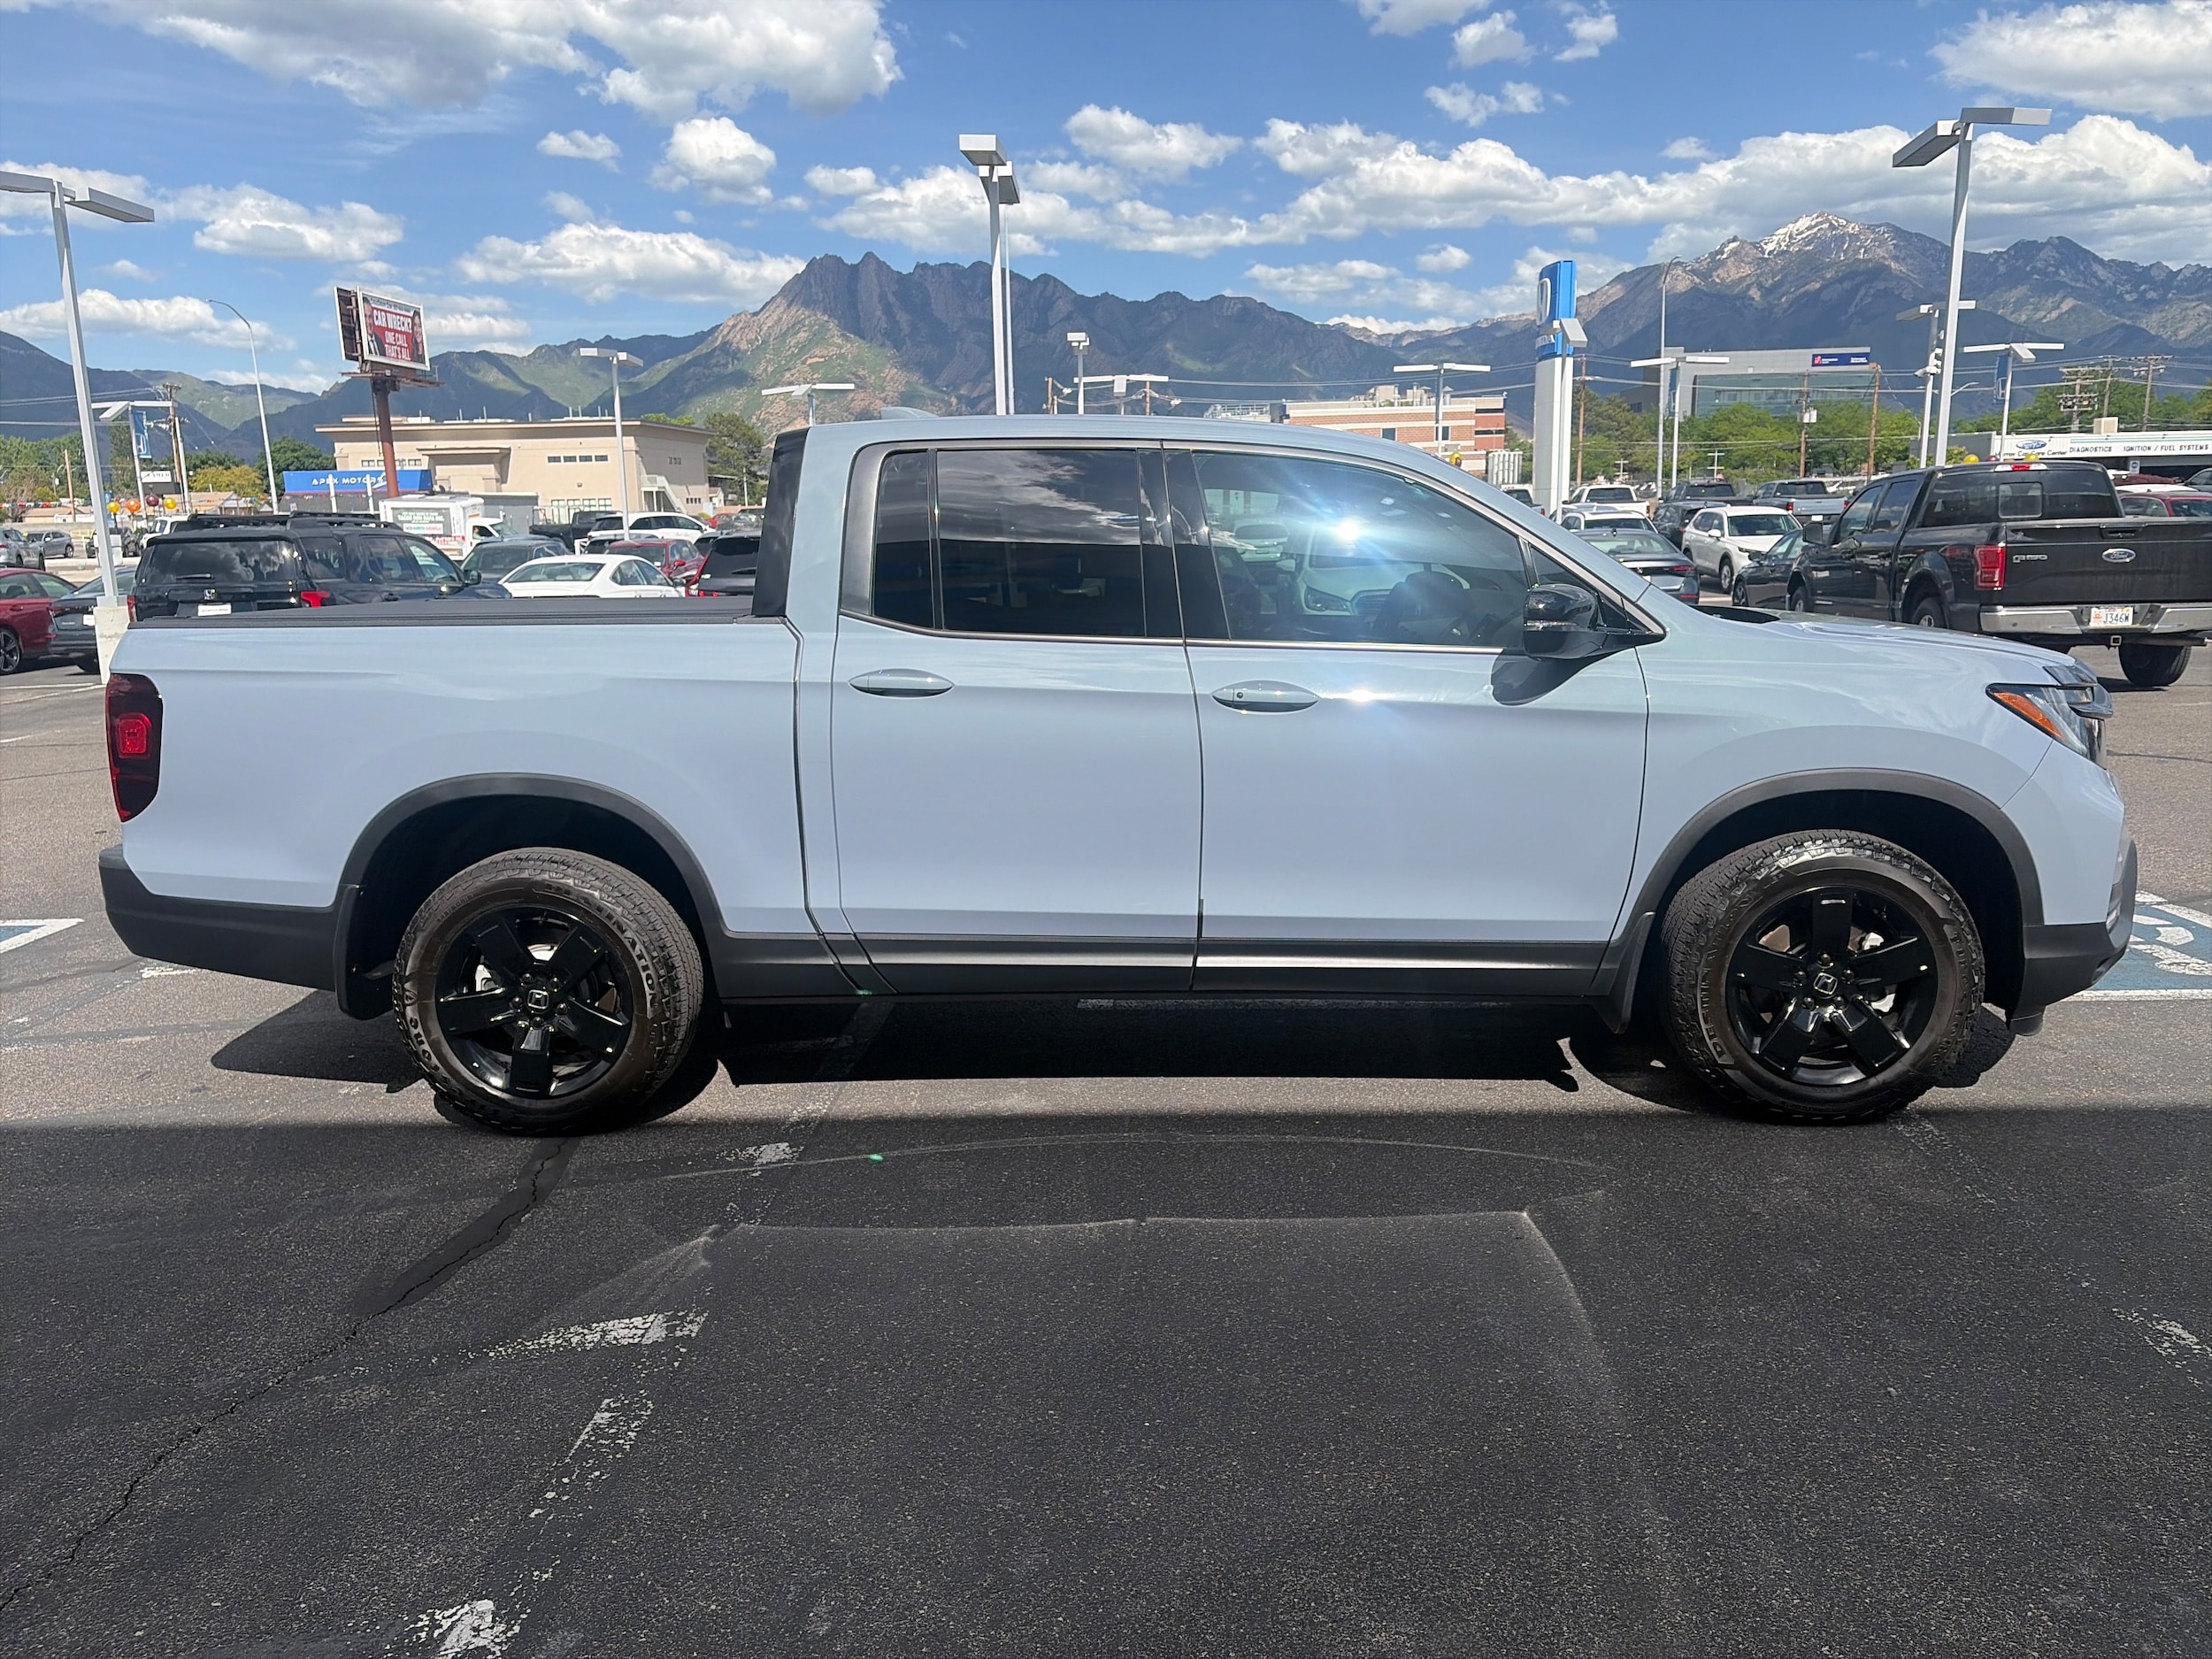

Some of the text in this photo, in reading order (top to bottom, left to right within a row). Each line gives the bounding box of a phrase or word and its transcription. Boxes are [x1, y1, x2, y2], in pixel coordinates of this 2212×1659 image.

[373, 309, 412, 334] CAR WRECK?
[384, 331, 408, 348] ONE CALL
[384, 344, 411, 361] THAT'S ALL
